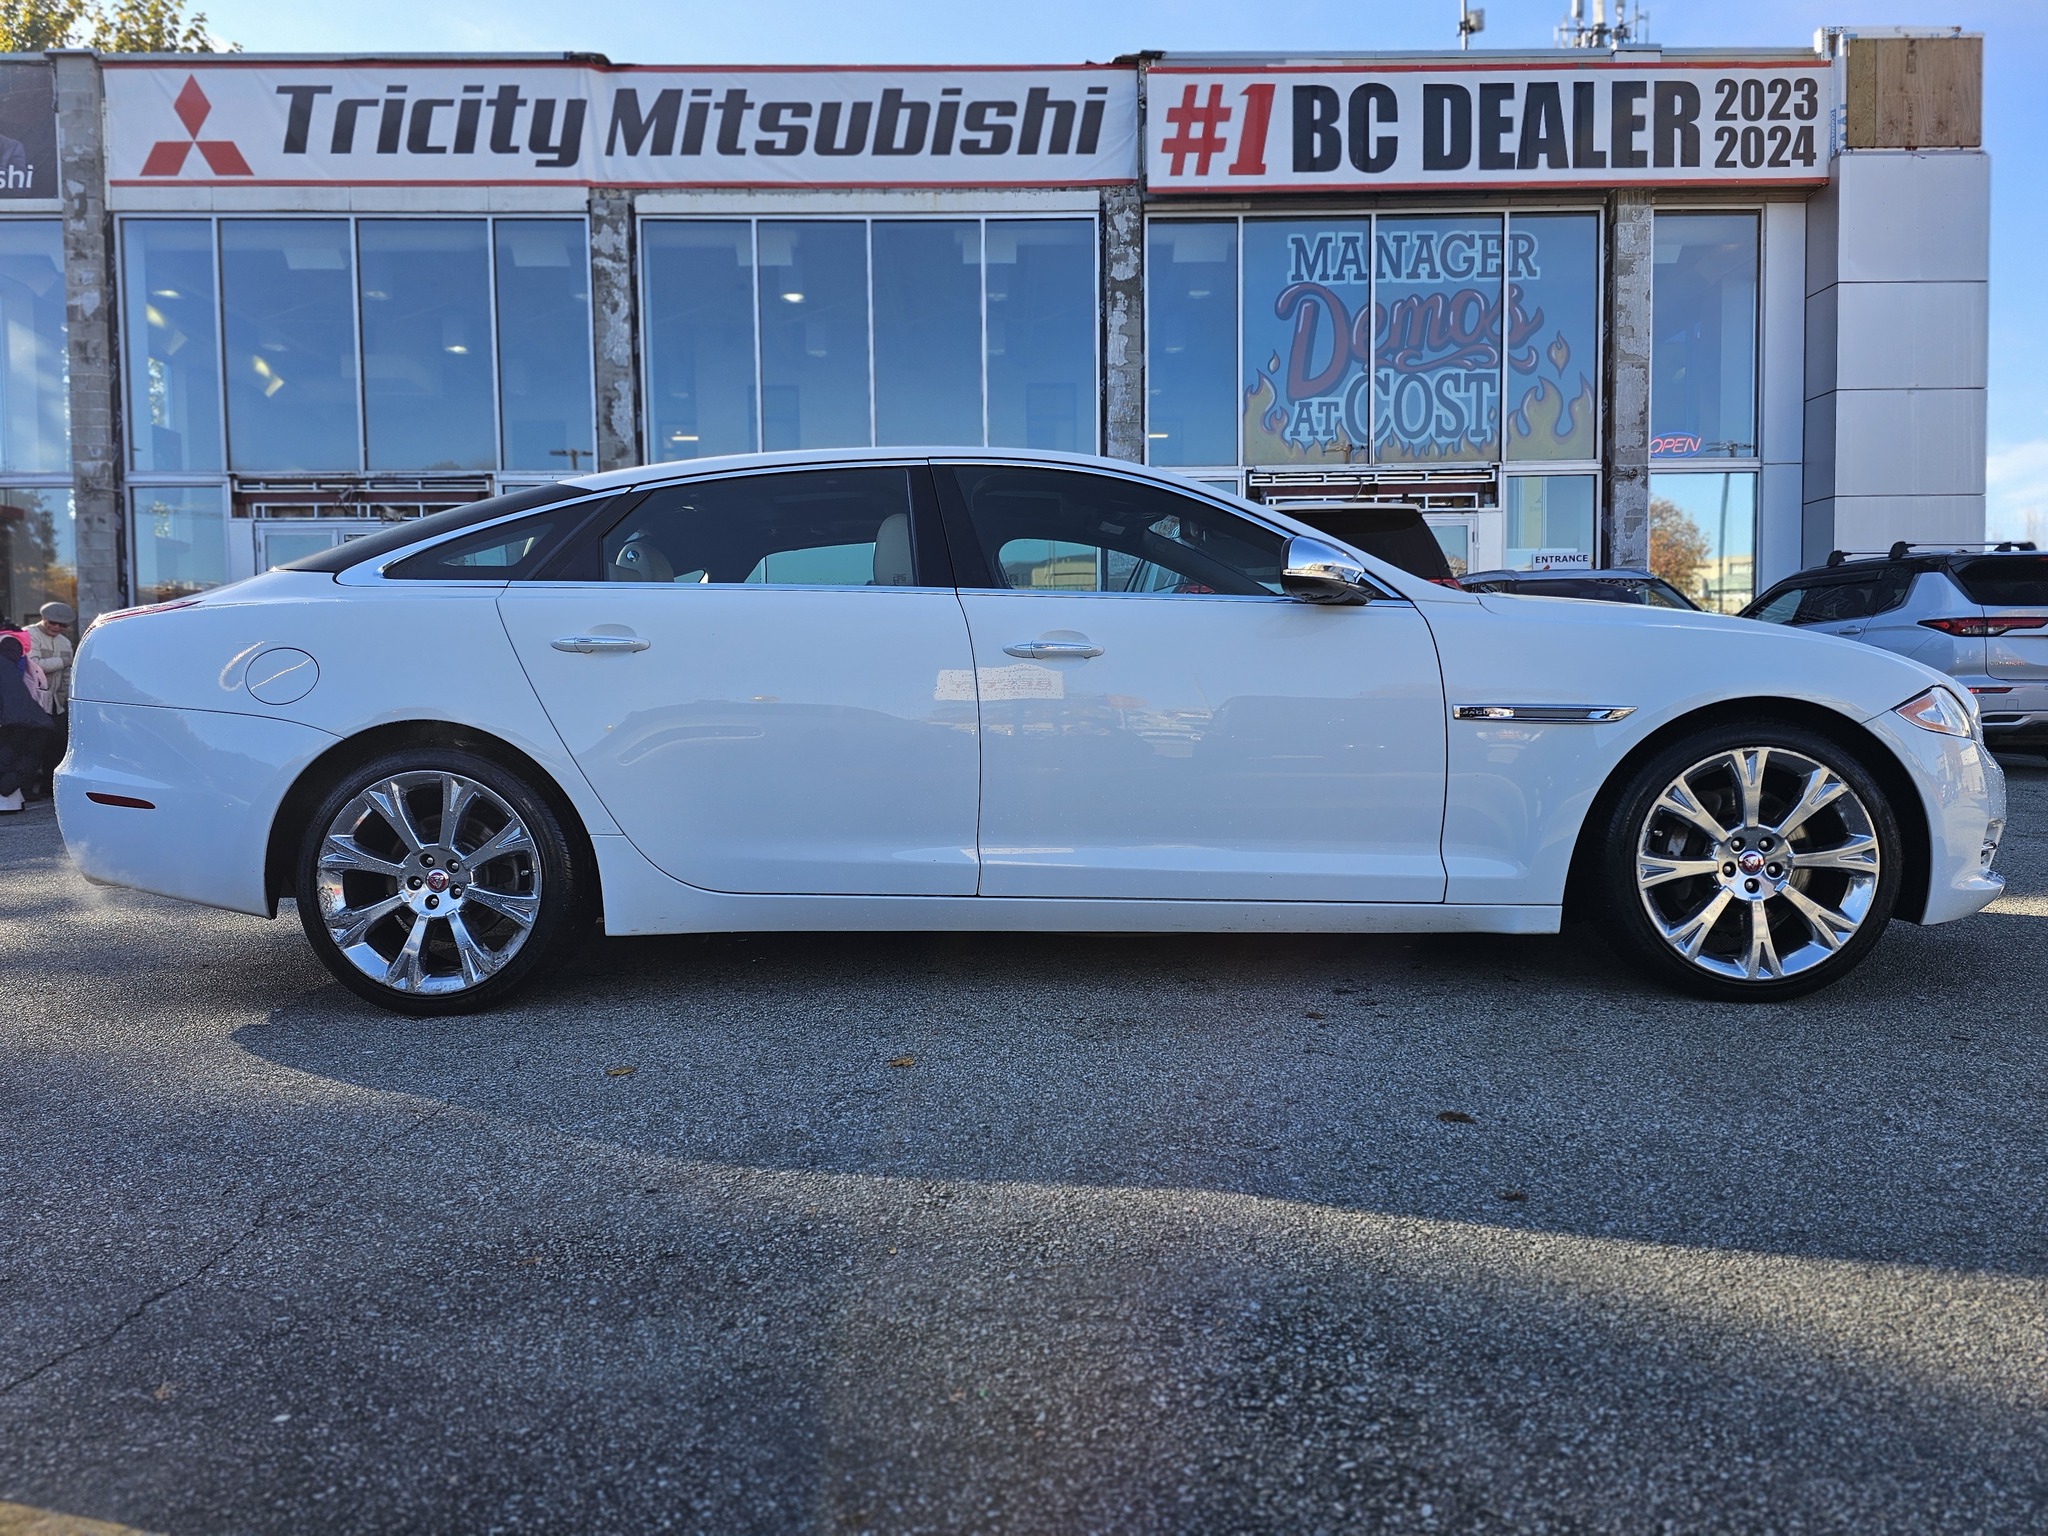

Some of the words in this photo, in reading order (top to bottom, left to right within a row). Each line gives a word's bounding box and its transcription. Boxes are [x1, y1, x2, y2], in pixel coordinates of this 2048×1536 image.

[1714, 78, 1818, 122] 2023
[276, 85, 588, 168] Tricity
[605, 86, 1109, 157] Mitsubishi
[1161, 83, 1277, 176] #1
[1292, 82, 1399, 174] BC
[1422, 80, 1701, 171] DEALER
[1714, 125, 1818, 169] 2024
[1289, 232, 1539, 282] MANAGER
[1275, 281, 1545, 403] Demos
[1289, 401, 1340, 437] AT
[1346, 372, 1496, 441] COST
[1650, 437, 1702, 454] OPEN
[1535, 554, 1589, 564] ENTRANCE
